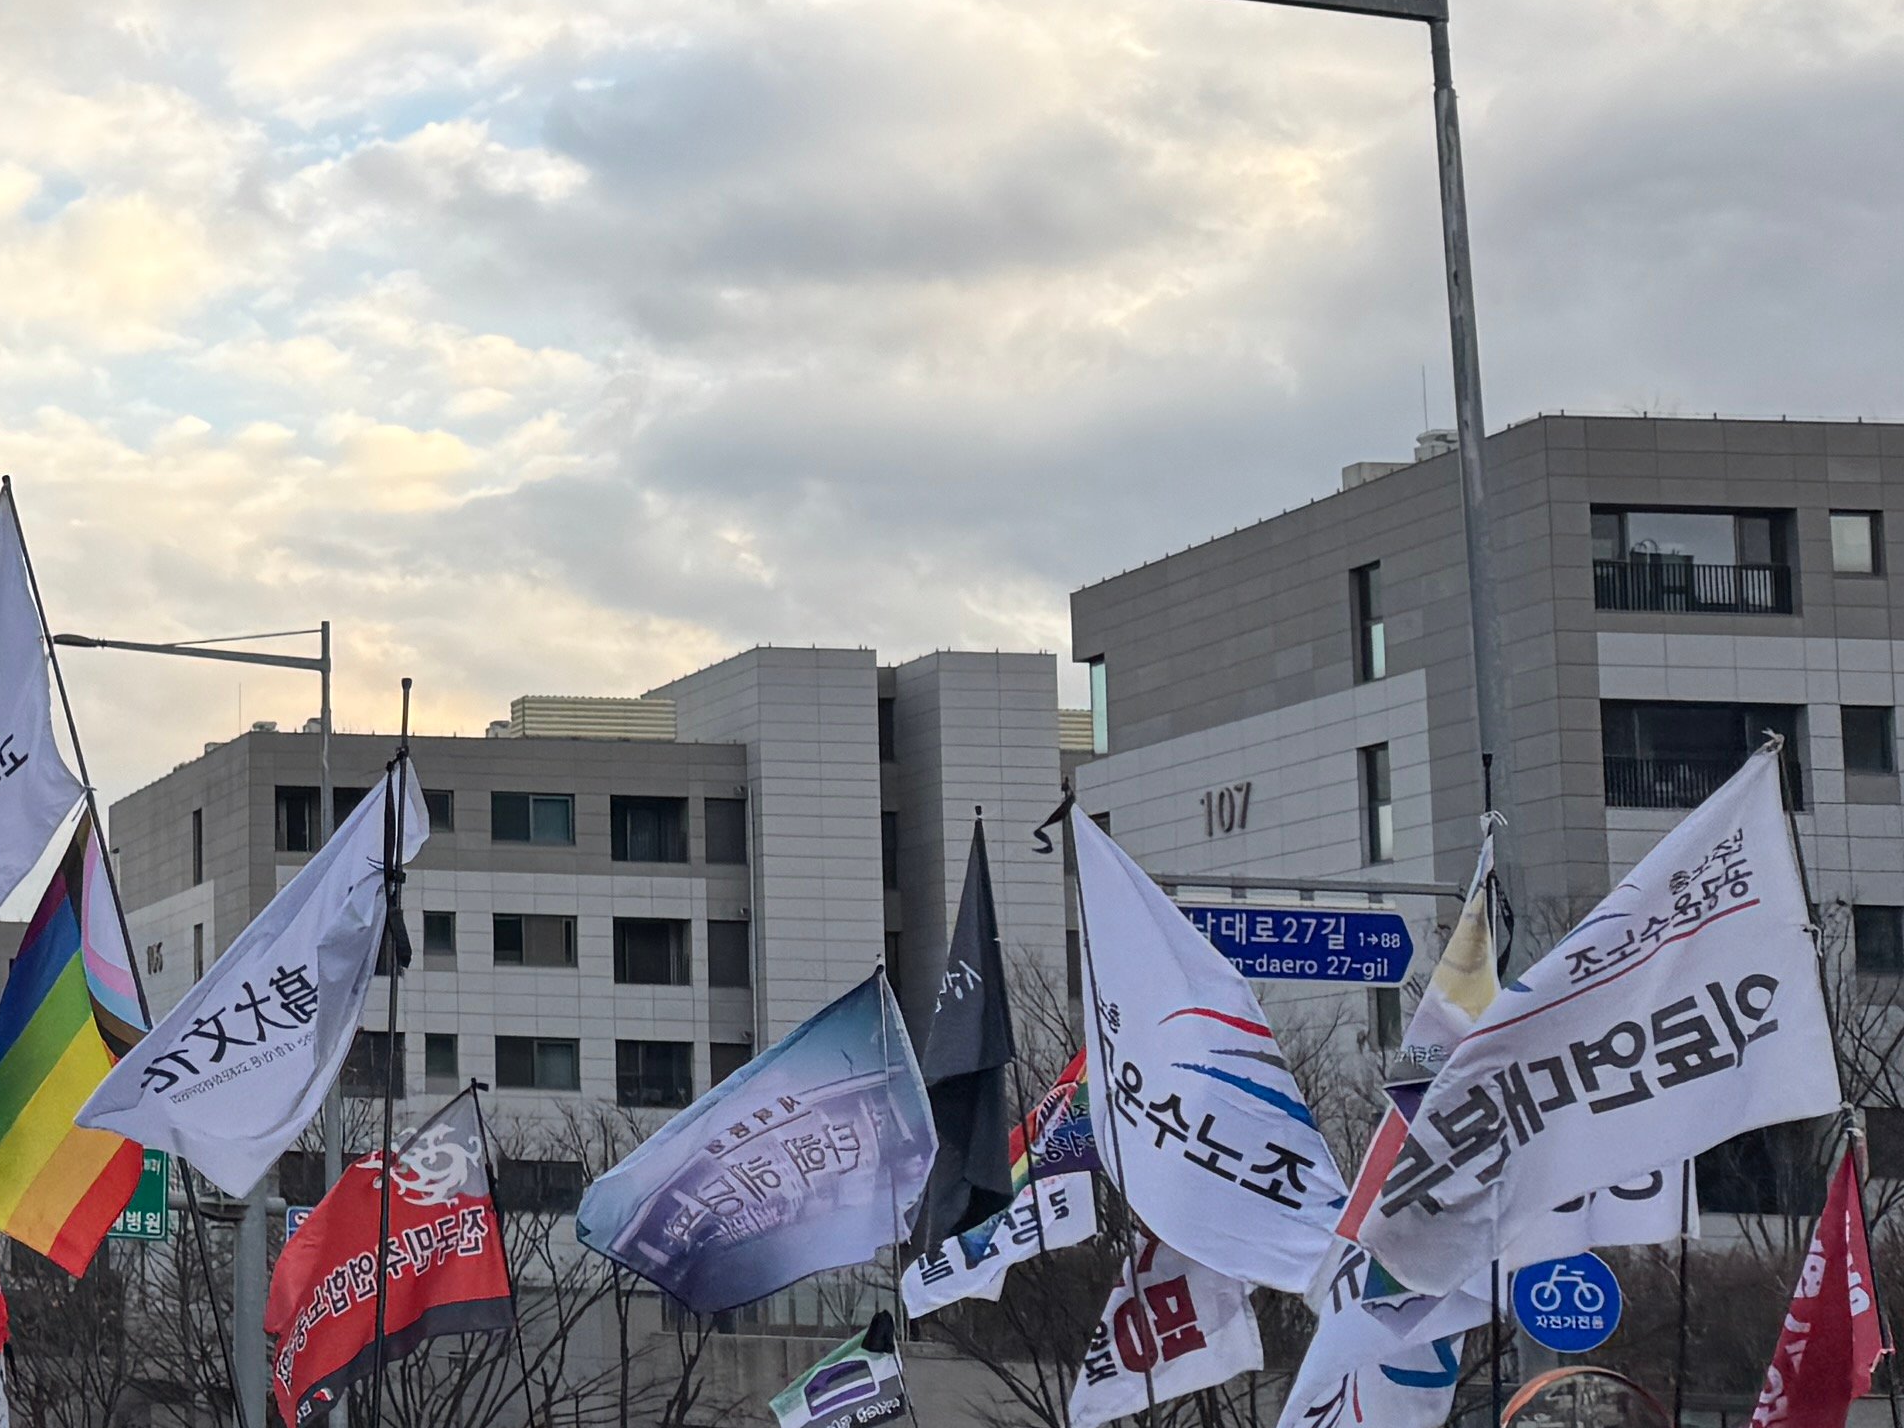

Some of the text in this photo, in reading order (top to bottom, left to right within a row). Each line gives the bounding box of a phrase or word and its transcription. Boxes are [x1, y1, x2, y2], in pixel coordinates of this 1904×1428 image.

[1199, 781, 1252, 838] 107
[1190, 911, 1346, 950] 남대로27길
[1327, 956, 1388, 981] 27-gil
[1103, 1033, 1315, 1210] 운수노조
[1536, 1316, 1604, 1329] 자전거전용
